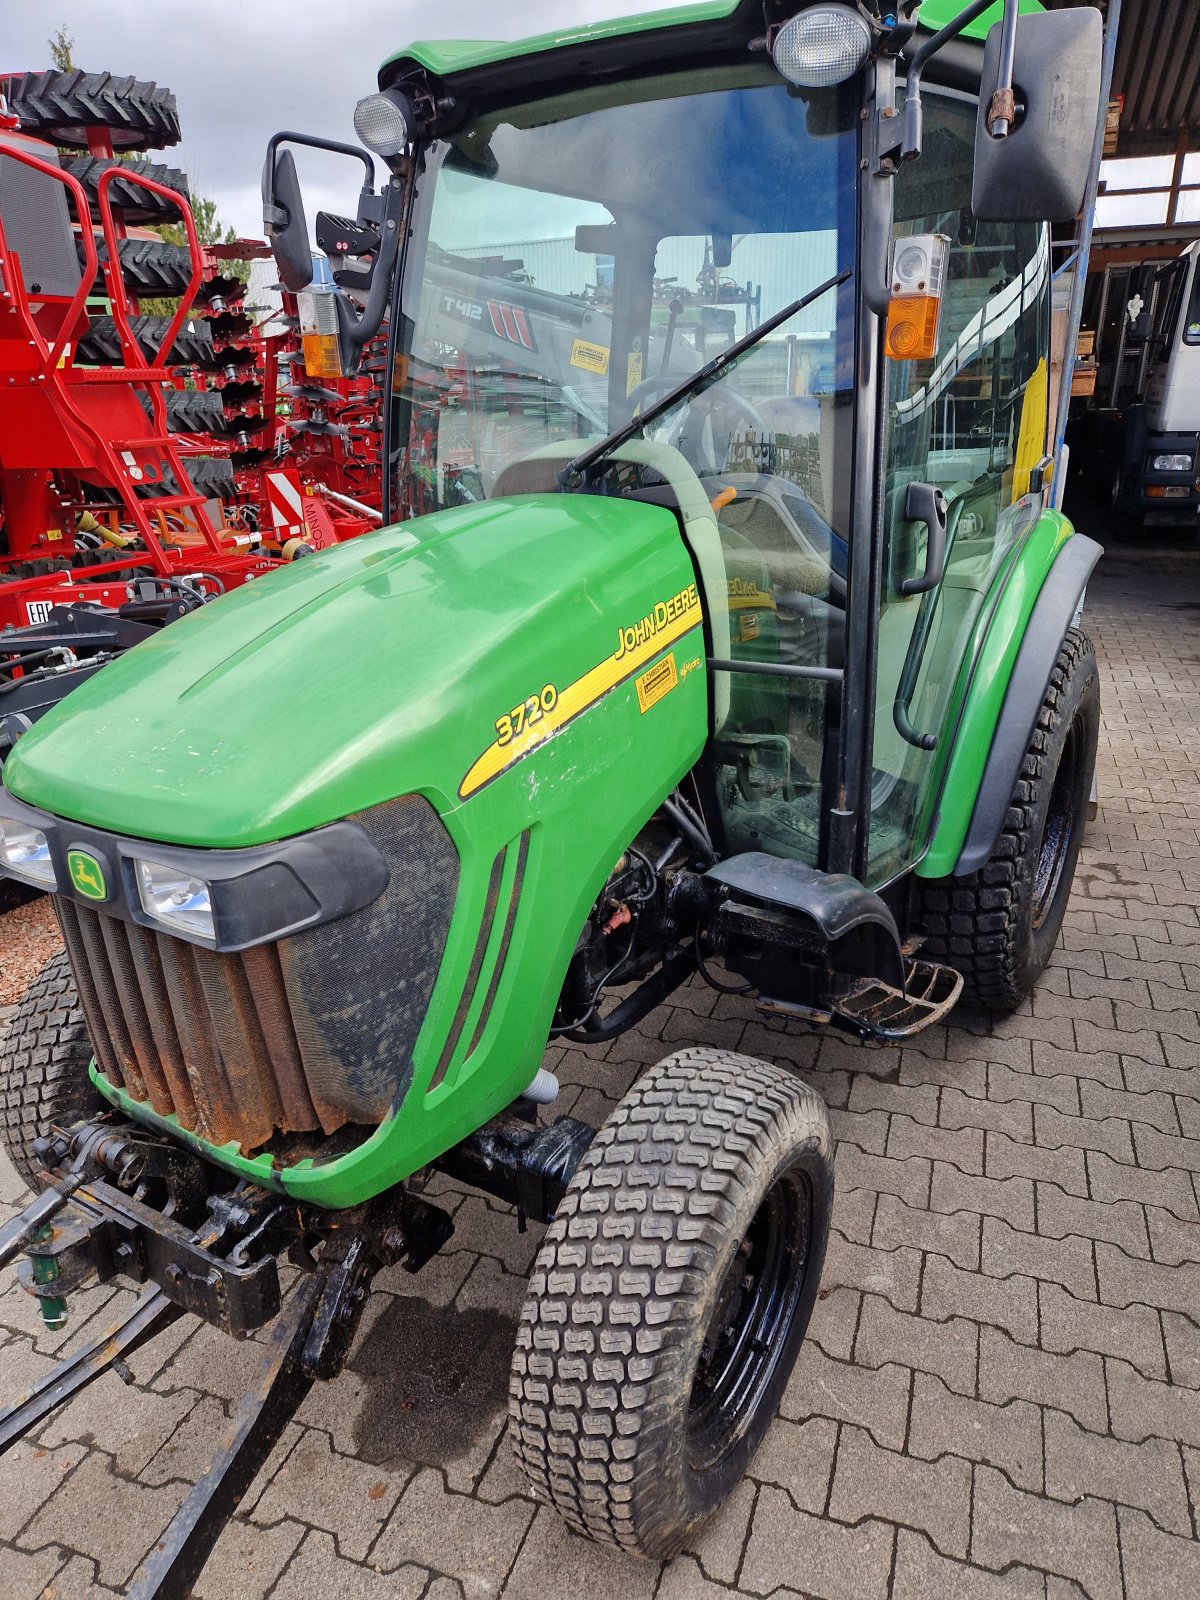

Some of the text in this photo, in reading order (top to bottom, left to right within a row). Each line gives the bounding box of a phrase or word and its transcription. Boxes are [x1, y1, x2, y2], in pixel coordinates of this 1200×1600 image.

[444, 296, 482, 320] T 412
[304, 503, 326, 551] MINOS
[615, 582, 698, 660] JOHN DEERE
[645, 658, 670, 681] CHRISTIAN
[495, 683, 558, 747] 3720
